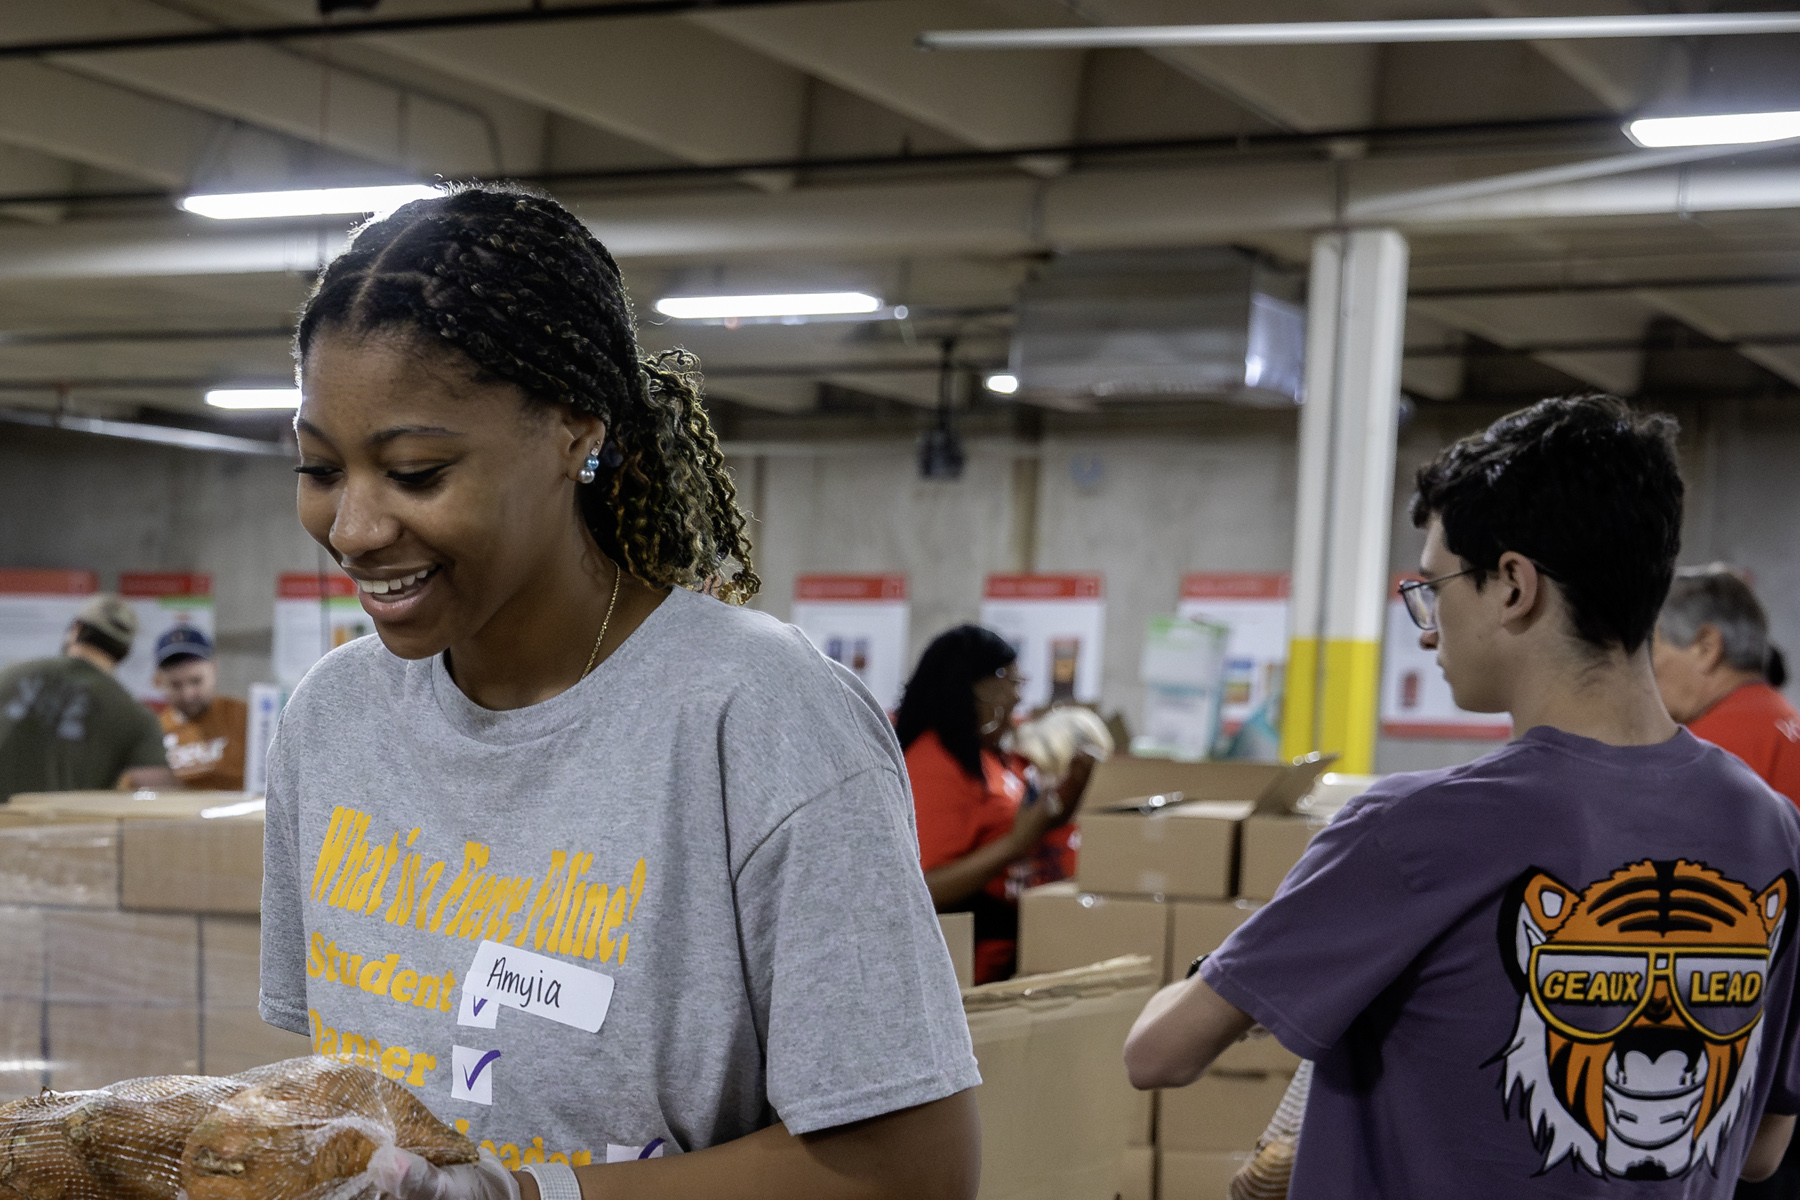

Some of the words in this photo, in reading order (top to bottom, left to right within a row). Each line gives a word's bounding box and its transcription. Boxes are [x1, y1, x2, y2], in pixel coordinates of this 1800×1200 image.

[310, 805, 399, 915] What
[385, 826, 422, 926] is
[415, 860, 446, 933] a
[443, 840, 534, 944] Fierce
[513, 849, 646, 965] Feline?
[306, 931, 456, 1012] Student
[487, 956, 561, 1008] Amyia
[1543, 971, 1641, 1002] GEAUX
[1690, 971, 1762, 1002] LEAD
